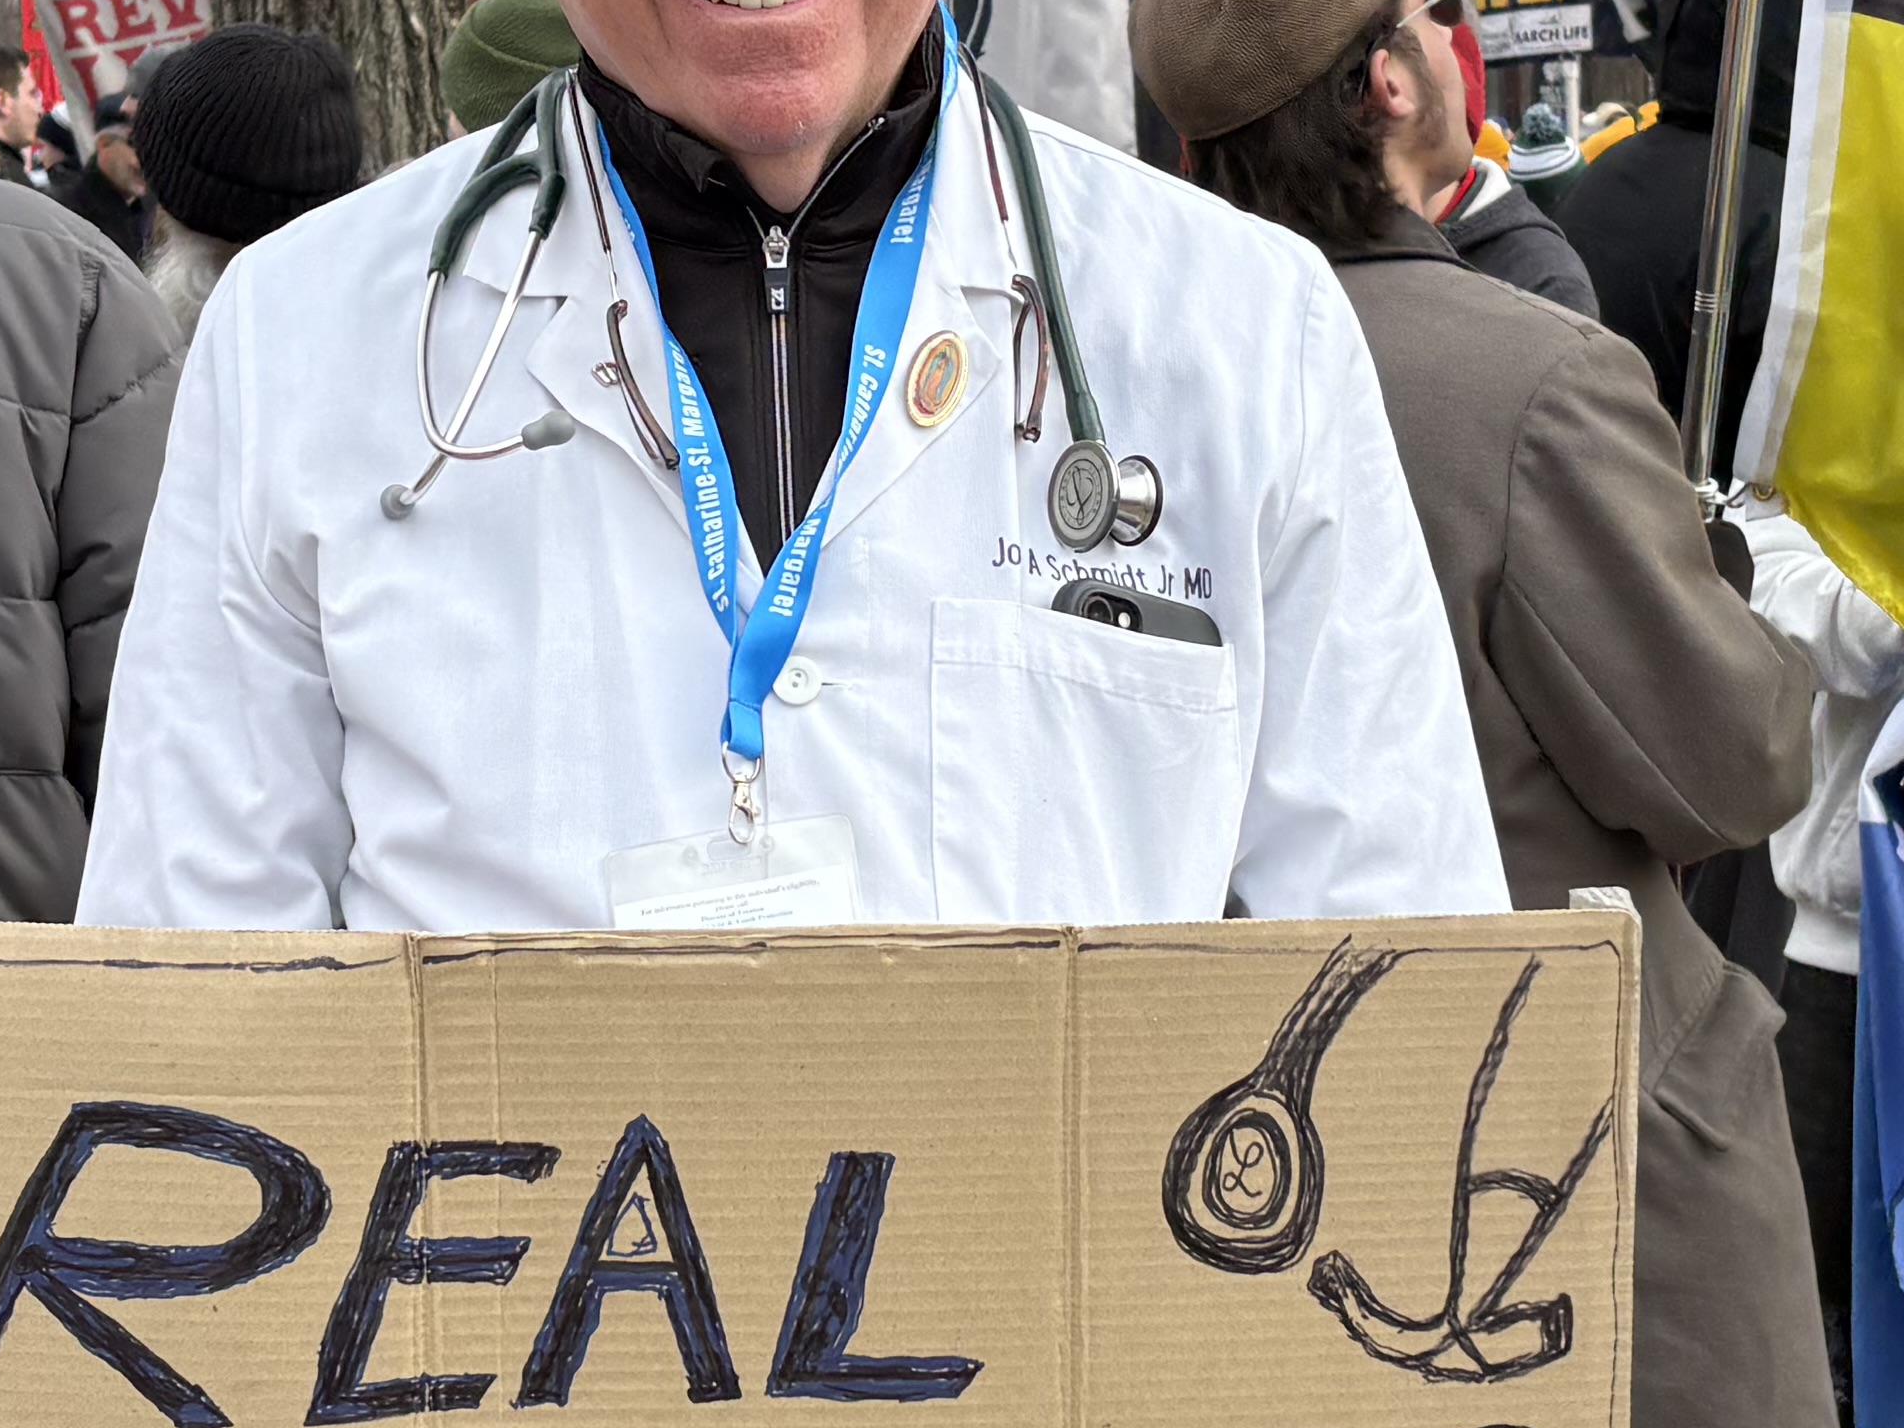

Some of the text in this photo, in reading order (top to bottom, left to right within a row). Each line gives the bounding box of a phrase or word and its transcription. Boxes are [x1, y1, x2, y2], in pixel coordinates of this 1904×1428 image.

[1045, 553, 1149, 592] Schmidt
[1157, 564, 1175, 597] Jr
[1183, 566, 1213, 601] MD
